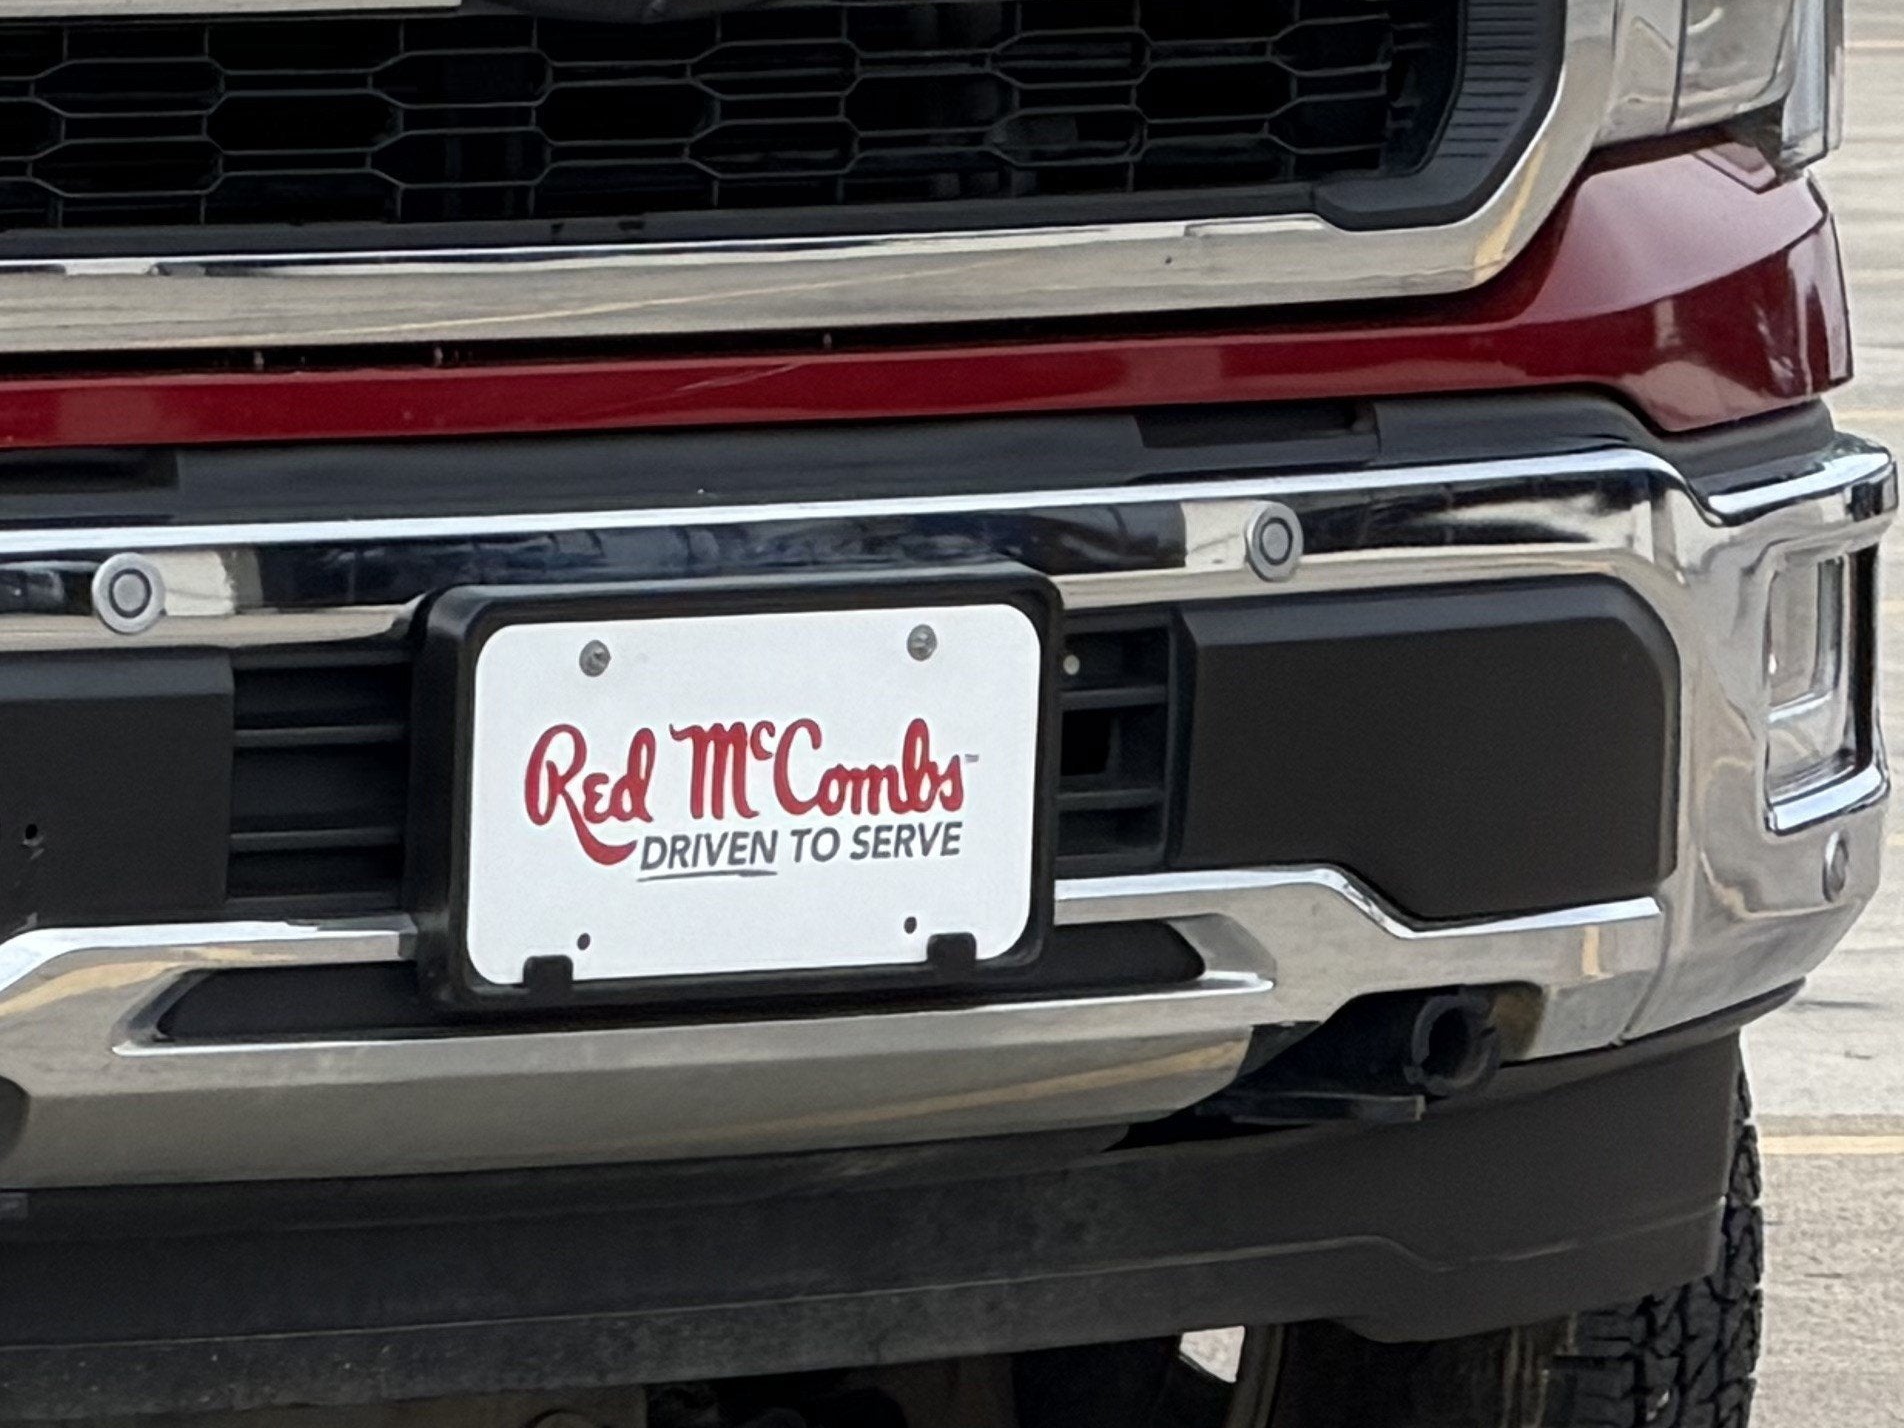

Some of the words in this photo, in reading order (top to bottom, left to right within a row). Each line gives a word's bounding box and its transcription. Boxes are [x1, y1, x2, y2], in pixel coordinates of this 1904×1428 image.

[524, 722, 656, 866] Red
[669, 717, 965, 821] McCombs
[639, 828, 779, 871] DRIVEN
[792, 825, 841, 863] TO
[848, 820, 964, 860] SERVE
